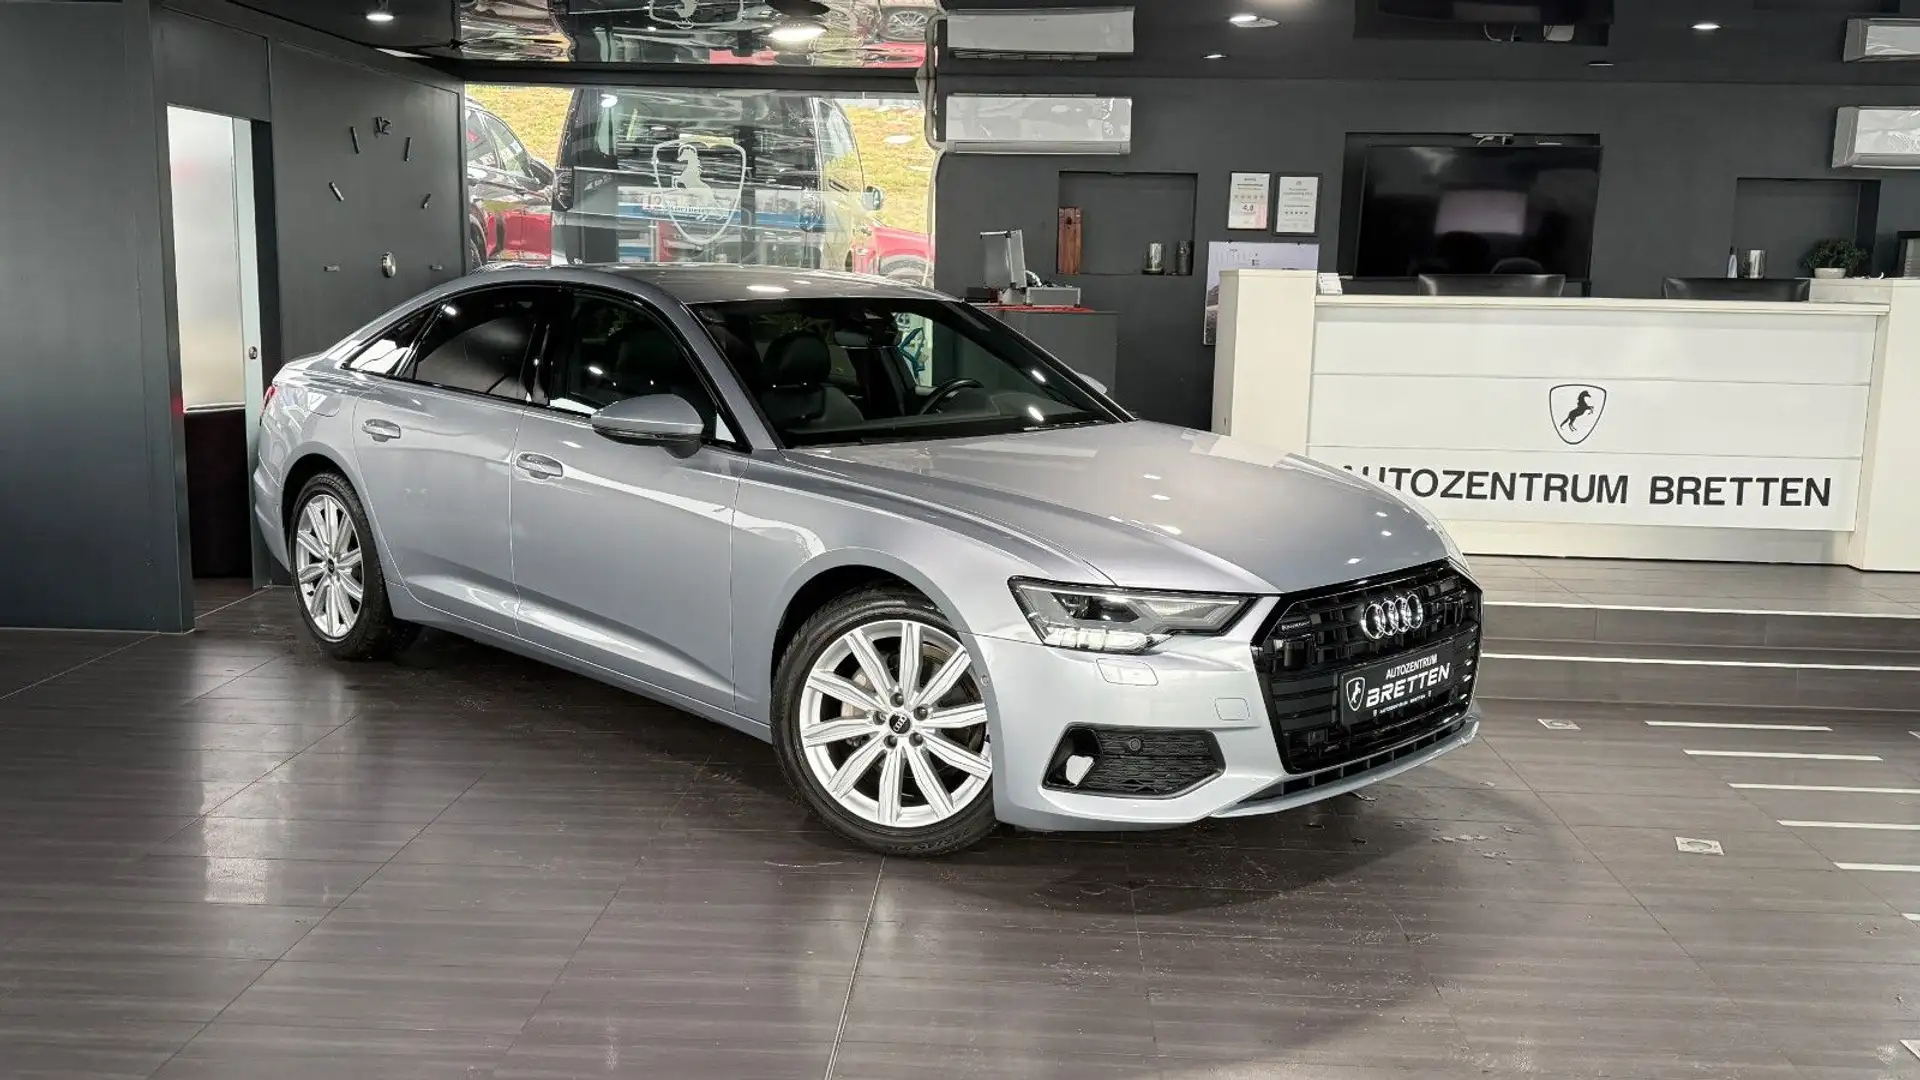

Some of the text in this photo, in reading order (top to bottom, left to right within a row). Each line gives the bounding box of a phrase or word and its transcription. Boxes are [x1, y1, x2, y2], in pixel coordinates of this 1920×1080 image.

[1343, 465, 1831, 506] TOZENTRUM BRETTEN
[1366, 663, 1450, 708] BRETTEN
[1386, 654, 1438, 680] AUTOZENTRUM
